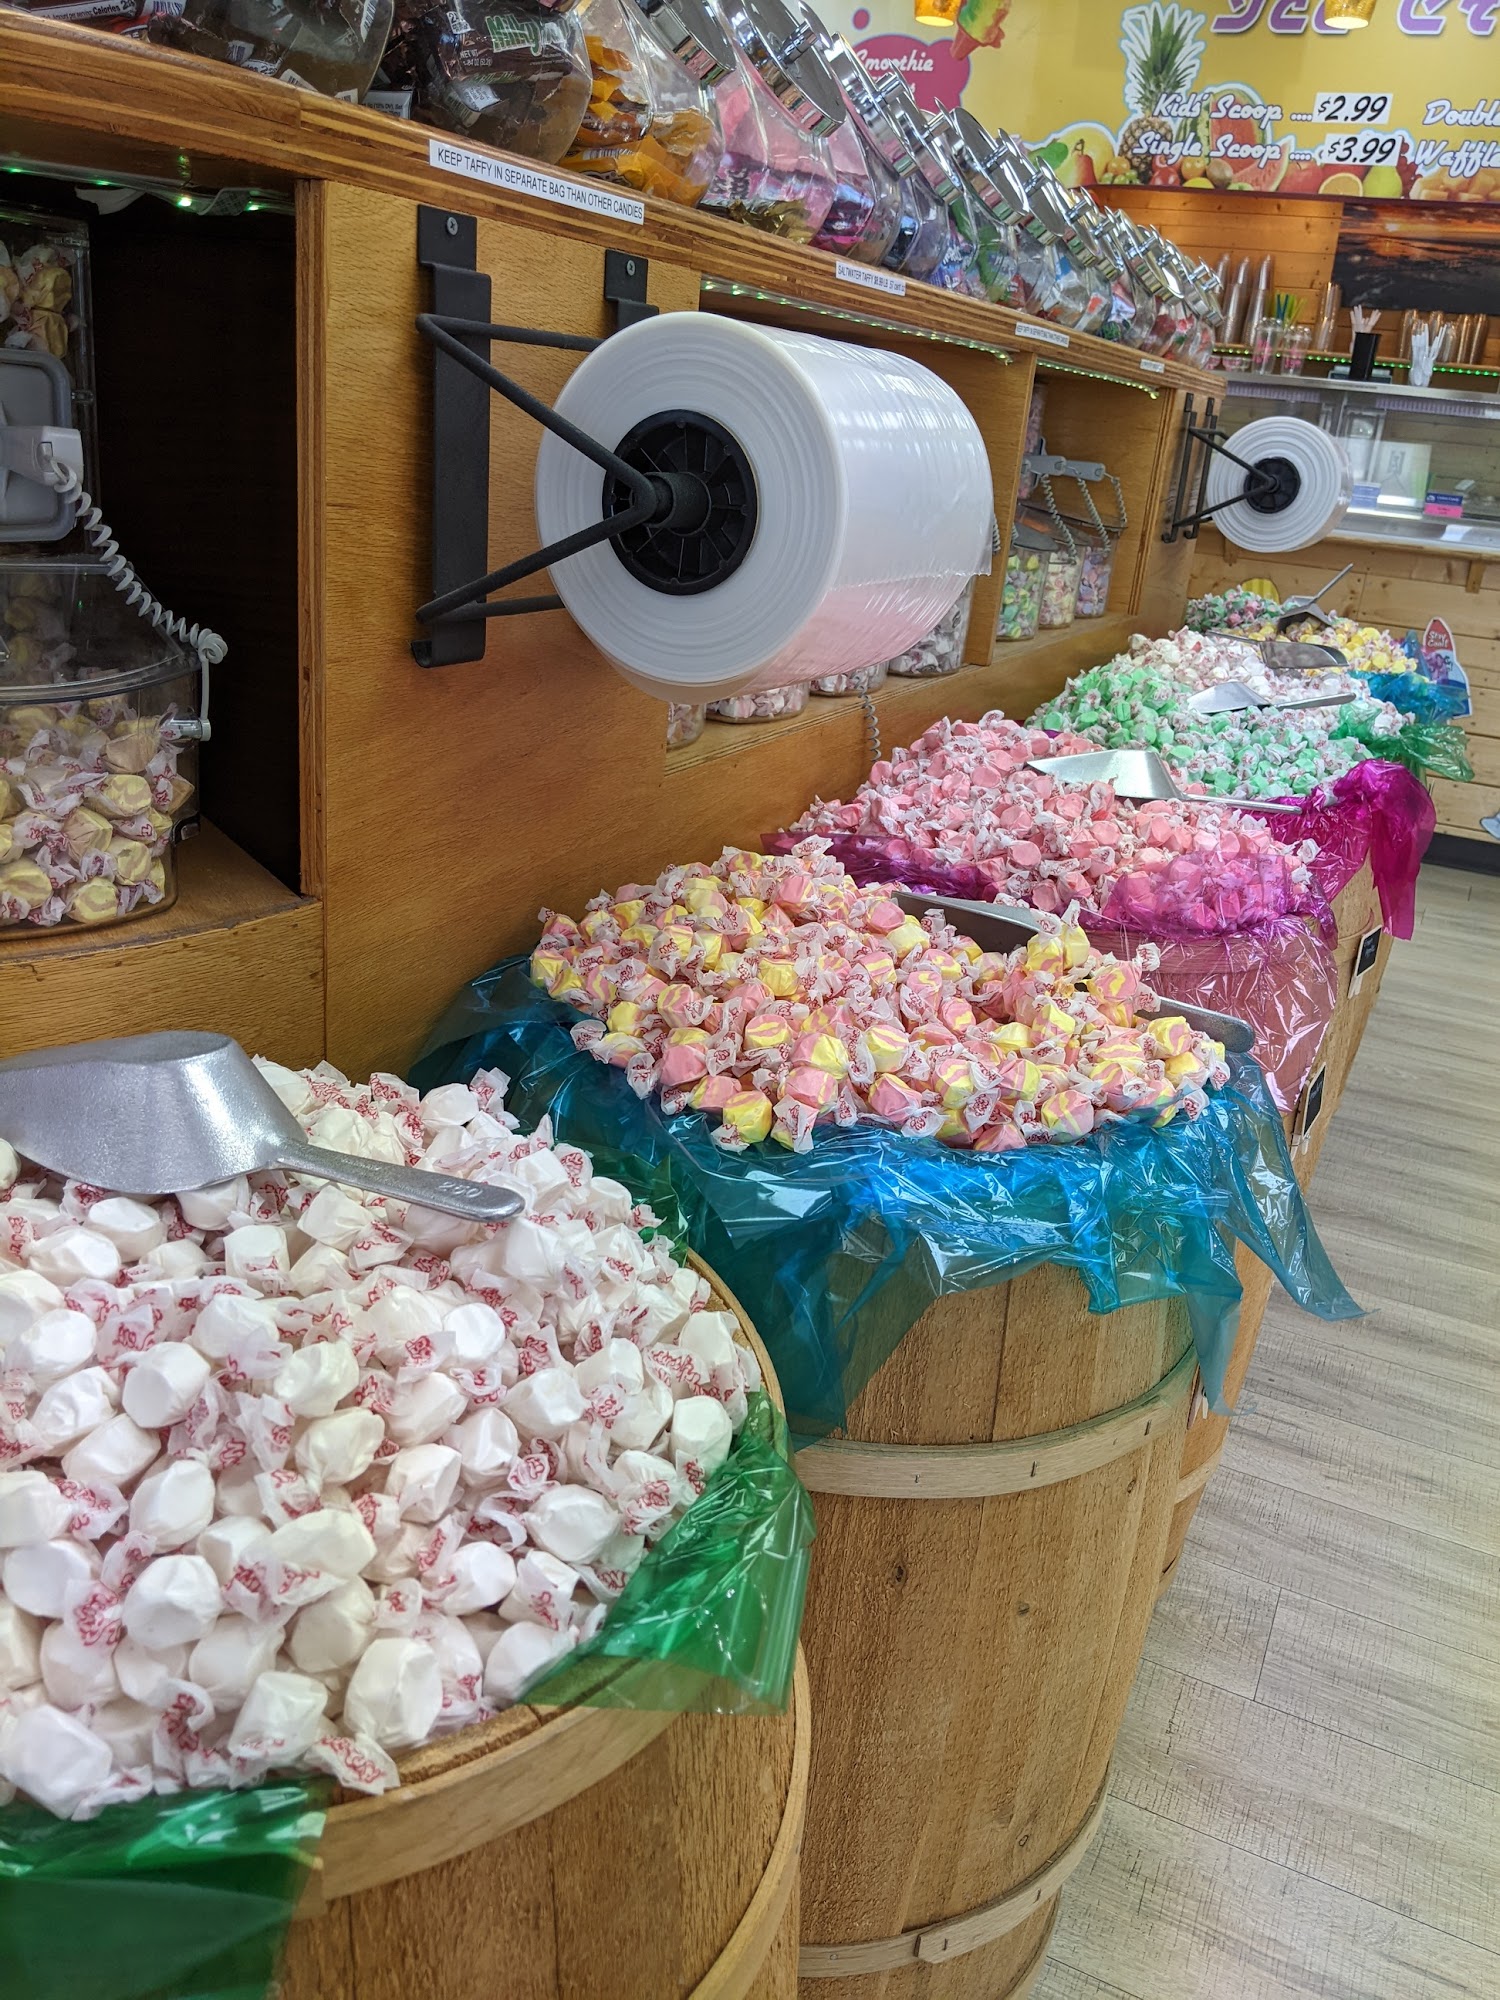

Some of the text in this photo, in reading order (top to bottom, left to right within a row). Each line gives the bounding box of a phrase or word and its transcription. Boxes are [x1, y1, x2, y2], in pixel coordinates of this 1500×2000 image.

[485, 14, 542, 56] Milky
[1152, 92, 1213, 118] Kids'
[1210, 94, 1283, 130] Scoop
[1318, 95, 1388, 123] $2.99
[1132, 130, 1202, 166] Single
[1209, 133, 1281, 170] Scoop
[1328, 136, 1396, 164] $3.99
[438, 148, 643, 220] KEEP TAFFY IN SEPARATE BAG THAN OTHER CANDIES
[838, 265, 861, 280] SALTWATER
[862, 272, 873, 284] TAFFY
